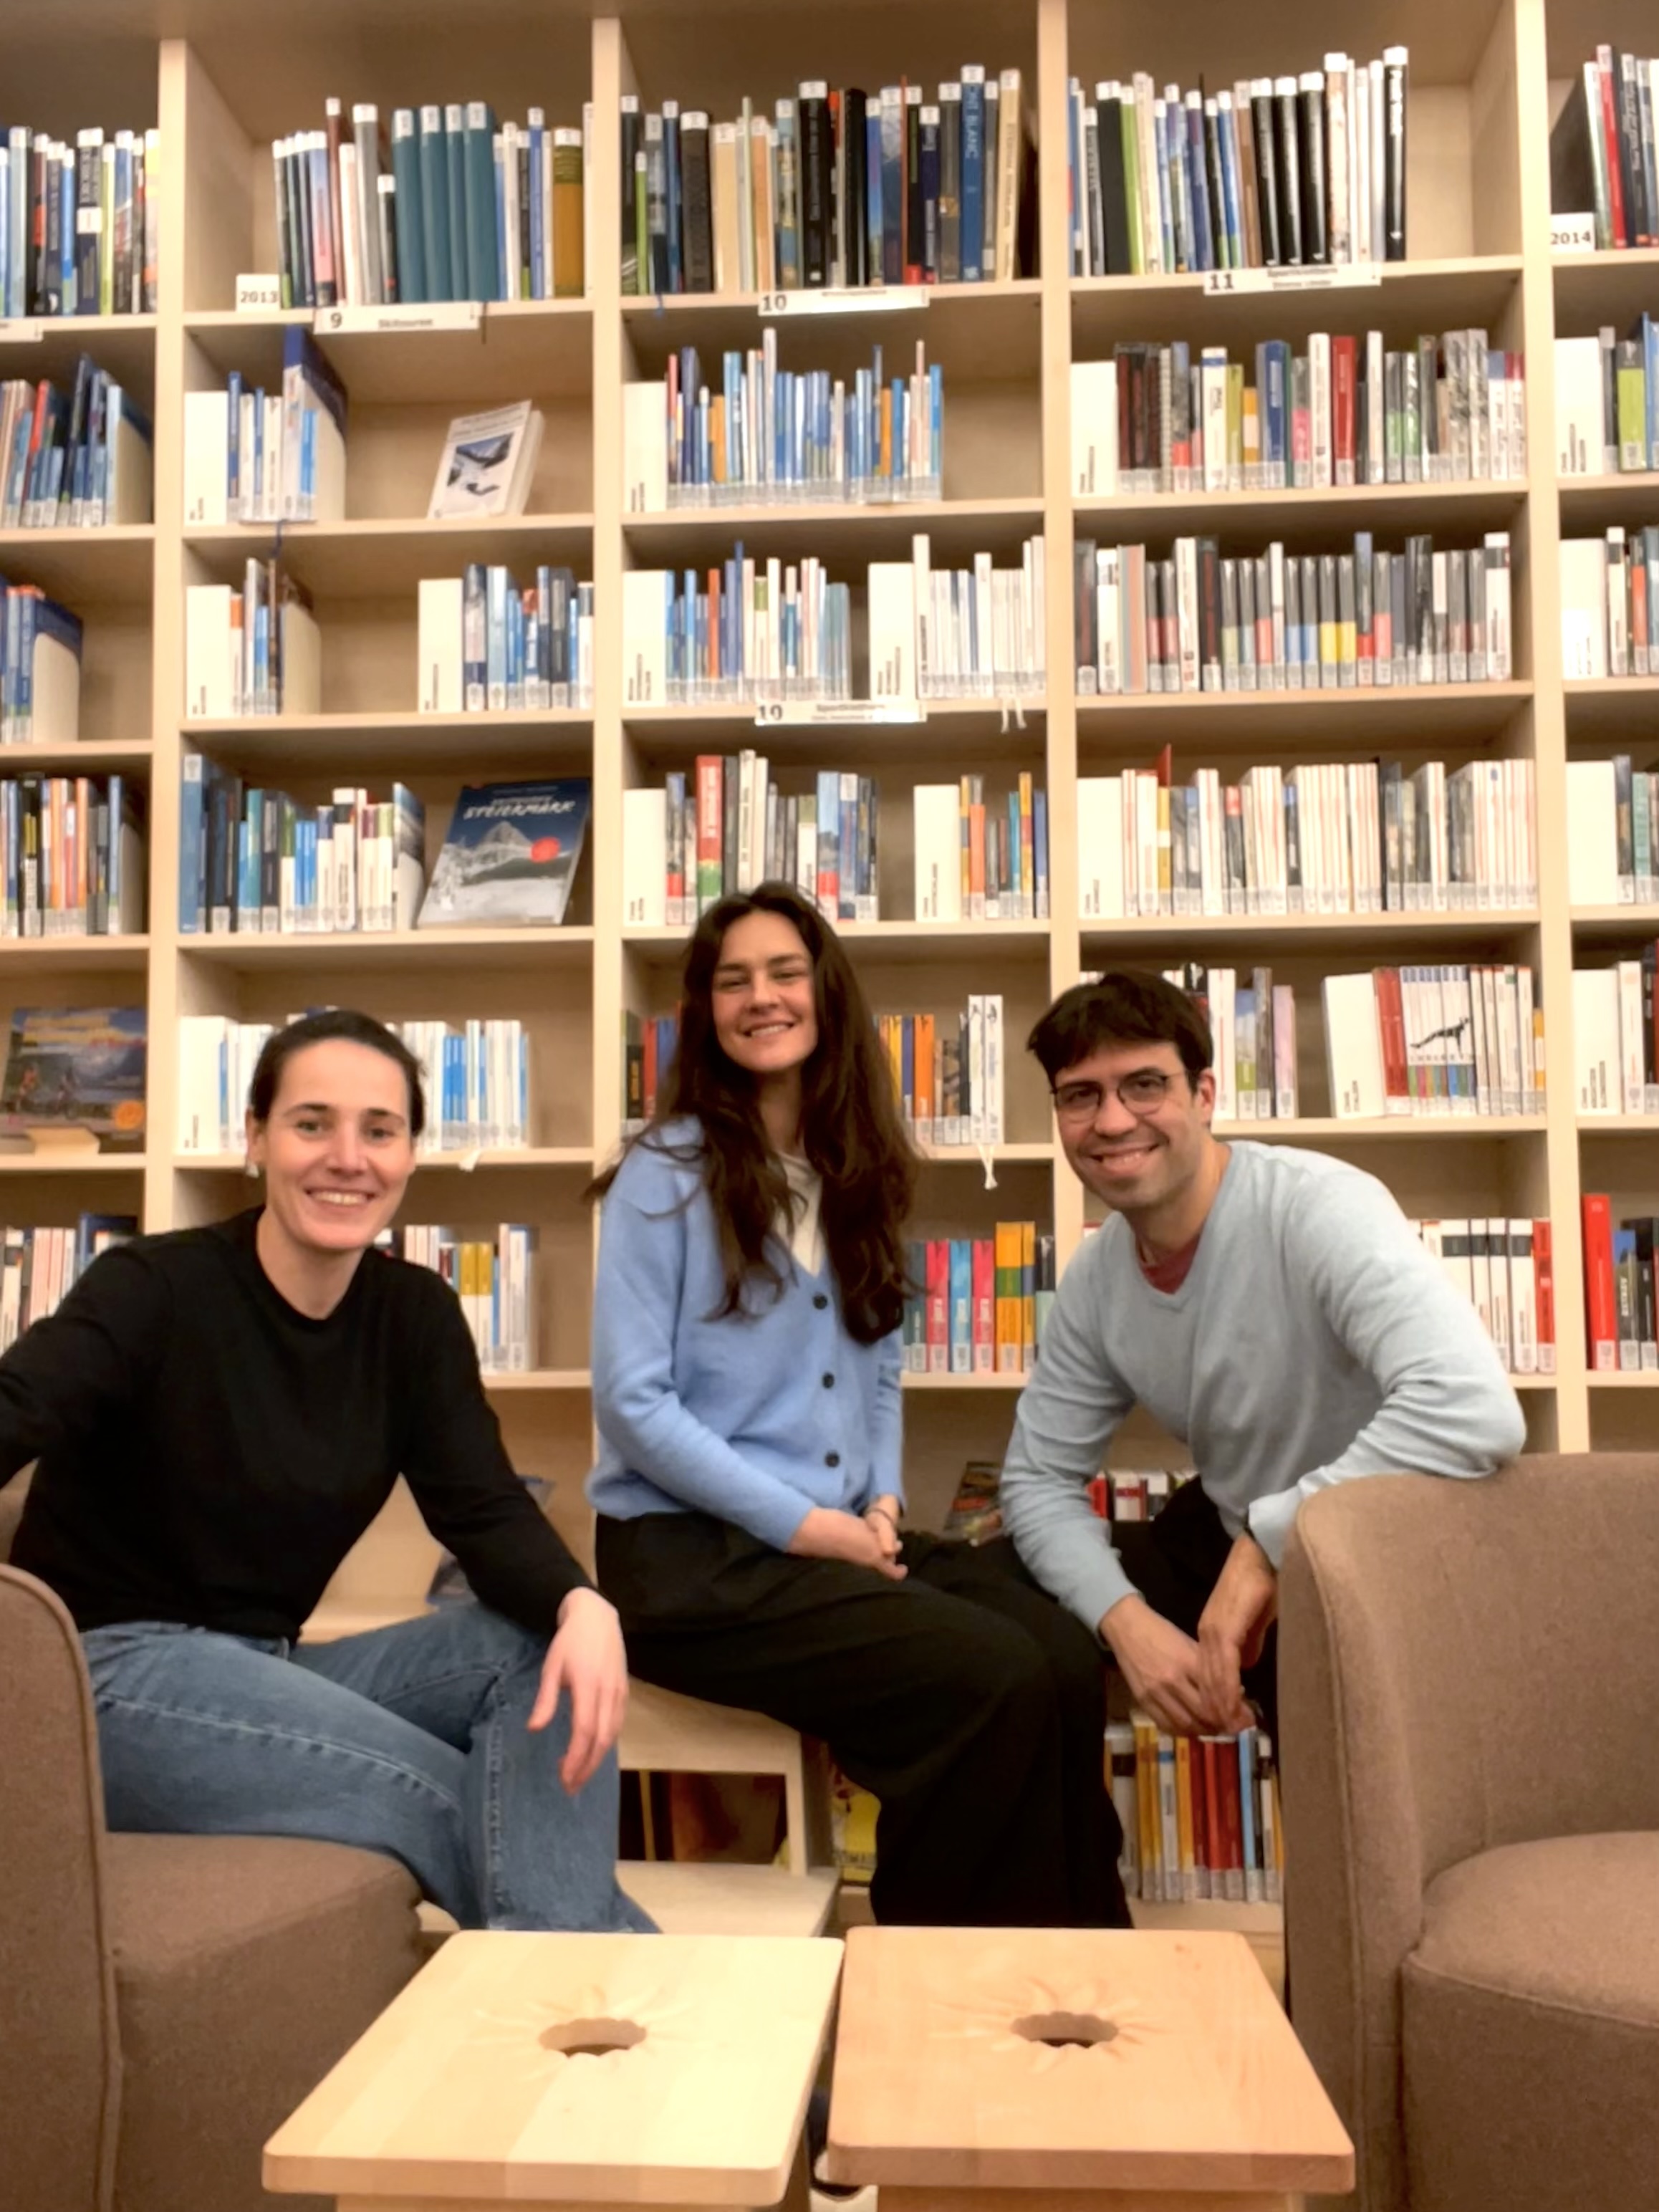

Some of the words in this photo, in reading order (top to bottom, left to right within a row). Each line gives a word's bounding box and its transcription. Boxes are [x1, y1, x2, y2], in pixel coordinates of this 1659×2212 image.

[1550, 231, 1592, 245] 2014
[1209, 273, 1234, 290] 11
[240, 291, 279, 304] 2013
[762, 294, 787, 312] 10
[330, 313, 342, 328] 9
[759, 704, 783, 721] 10
[463, 801, 576, 819] STEIERMARK
